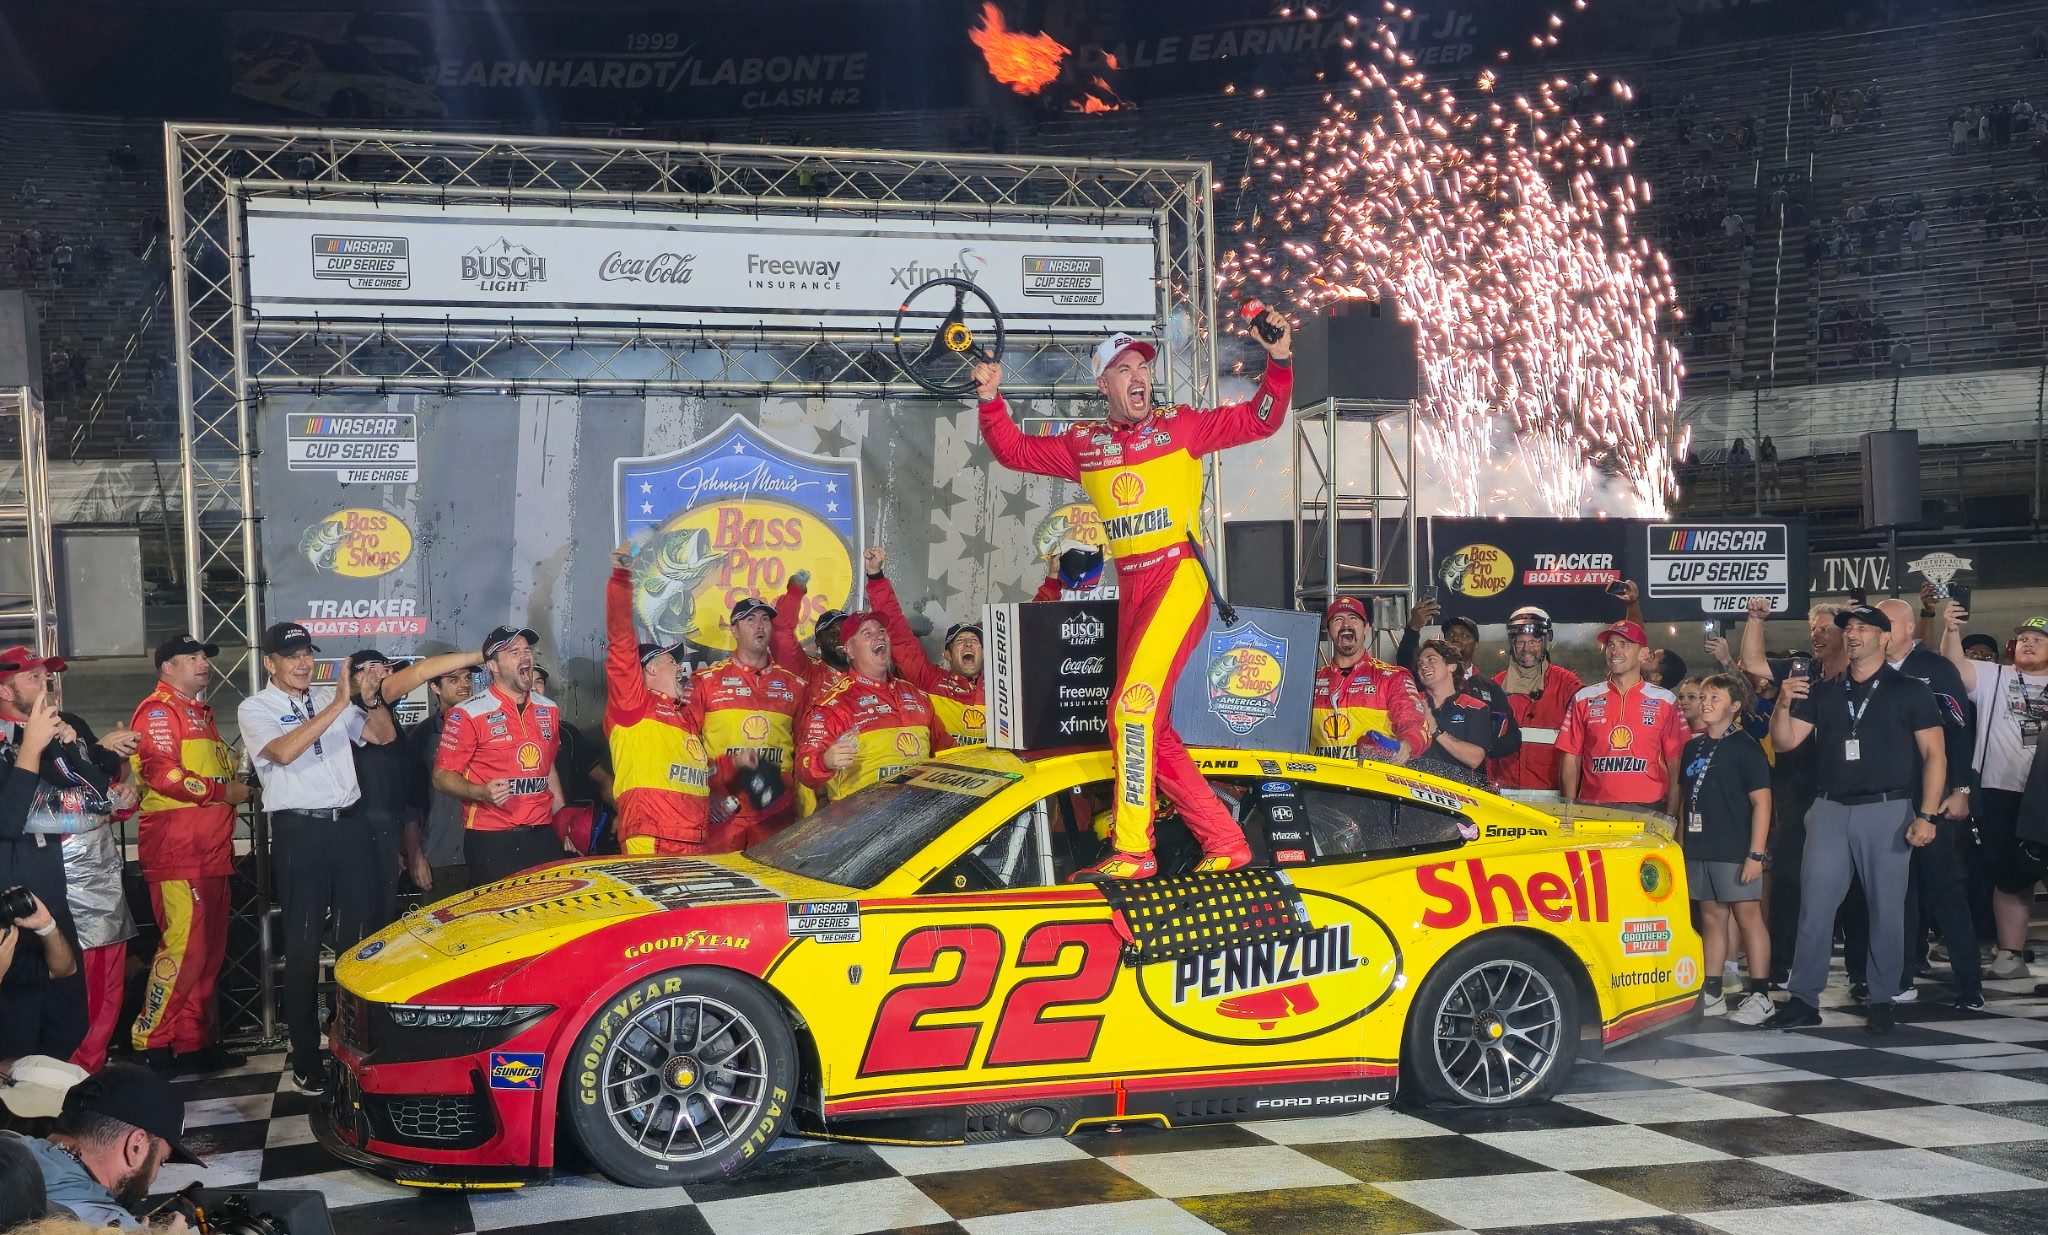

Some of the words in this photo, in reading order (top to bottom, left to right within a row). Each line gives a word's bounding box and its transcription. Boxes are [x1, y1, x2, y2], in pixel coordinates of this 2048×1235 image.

[626, 32, 680, 52] 1999
[1079, 35, 1181, 70] DALE
[1432, 10, 1478, 39] Jr.
[741, 88, 824, 111] CLASH
[829, 86, 861, 106] #2
[344, 240, 394, 255] NASCAR
[327, 258, 352, 271] CUP
[353, 258, 396, 272] SERIES
[461, 256, 547, 282] BUSCH
[599, 251, 699, 284] Coca-Cola
[747, 253, 842, 279] Freeway
[1048, 260, 1091, 273] NASCAR
[357, 278, 373, 288] THE
[374, 279, 402, 288] CHASE
[480, 280, 528, 292] LIGHT
[748, 281, 842, 291] INSURANCE
[1035, 277, 1056, 288] CUP
[1057, 276, 1093, 288] SERIES
[1059, 295, 1074, 303] THE
[1075, 295, 1098, 303] CHASE
[328, 418, 398, 435] NASCAR
[305, 443, 340, 459] CUP
[341, 443, 400, 459] SERIES
[348, 470, 368, 481] THE
[371, 470, 409, 481] CHASE
[677, 467, 749, 510] Johnny
[737, 460, 820, 492] Morris
[345, 511, 388, 531] Bass
[1068, 506, 1100, 524] Bas
[711, 507, 802, 550] Bass
[1072, 524, 1098, 541] Pro
[346, 530, 380, 550] Pro
[1694, 530, 1767, 551] NASCAR
[347, 549, 401, 571] Shops
[1470, 546, 1498, 562] Bass
[1533, 553, 1614, 570] TRACKER
[716, 549, 786, 589] Pro
[1470, 561, 1492, 577] Pro
[1528, 572, 1572, 584] BOATS
[1573, 573, 1580, 583] &
[1582, 571, 1615, 584] ATVs
[1667, 562, 1704, 582] CUP
[1706, 562, 1769, 582] SERIES
[1470, 573, 1507, 593] Shops
[307, 600, 417, 619] TRACKER
[1713, 596, 1736, 610] THE
[302, 620, 360, 634] BOATS
[364, 622, 373, 633] &
[374, 620, 419, 633] ATVs
[1061, 622, 1105, 640] BUSCH
[2025, 617, 2046, 628] 12
[995, 609, 1008, 676] SERIES
[1060, 656, 1106, 675] Coca-Cola
[1238, 649, 1268, 666] Bass
[1240, 663, 1260, 678] Pro
[1060, 685, 1110, 699] Freeway
[1236, 675, 1273, 694] Shops
[998, 679, 1009, 717] CUP
[1060, 700, 1109, 708] INSURANCE
[1220, 697, 1269, 708] AMERICA'S
[1060, 716, 1108, 735] xfinity
[1125, 722, 1146, 807] PENNZOIL
[1195, 760, 1239, 769] GANO
[922, 771, 990, 791] LOGANO
[1264, 782, 1288, 791] Ford
[1385, 773, 1481, 807] DISCOUNT
[1415, 789, 1458, 808] TIRE
[1272, 832, 1302, 840] Mazak
[1485, 824, 1548, 839] Snap-on
[1416, 849, 1609, 930] Shell
[810, 903, 848, 914] NASCAR
[798, 918, 817, 928] CUP
[818, 917, 850, 928] SERIES
[1633, 923, 1657, 932] HUNT
[624, 929, 752, 960] GOODYEAR
[834, 933, 856, 941] CHASE
[1624, 931, 1668, 942] BROTHERS
[1633, 941, 1659, 951] PIZZA
[1173, 923, 1360, 1004] PENNZOIL
[1611, 967, 1672, 989] Autotrader
[856, 919, 1122, 1080] 22
[580, 976, 682, 1106] GOODYEAR
[493, 1066, 542, 1078] SUNOCO
[1256, 1097, 1312, 1109] FORD
[1316, 1091, 1390, 1105] RACING
[739, 1086, 789, 1159] EAGLE
